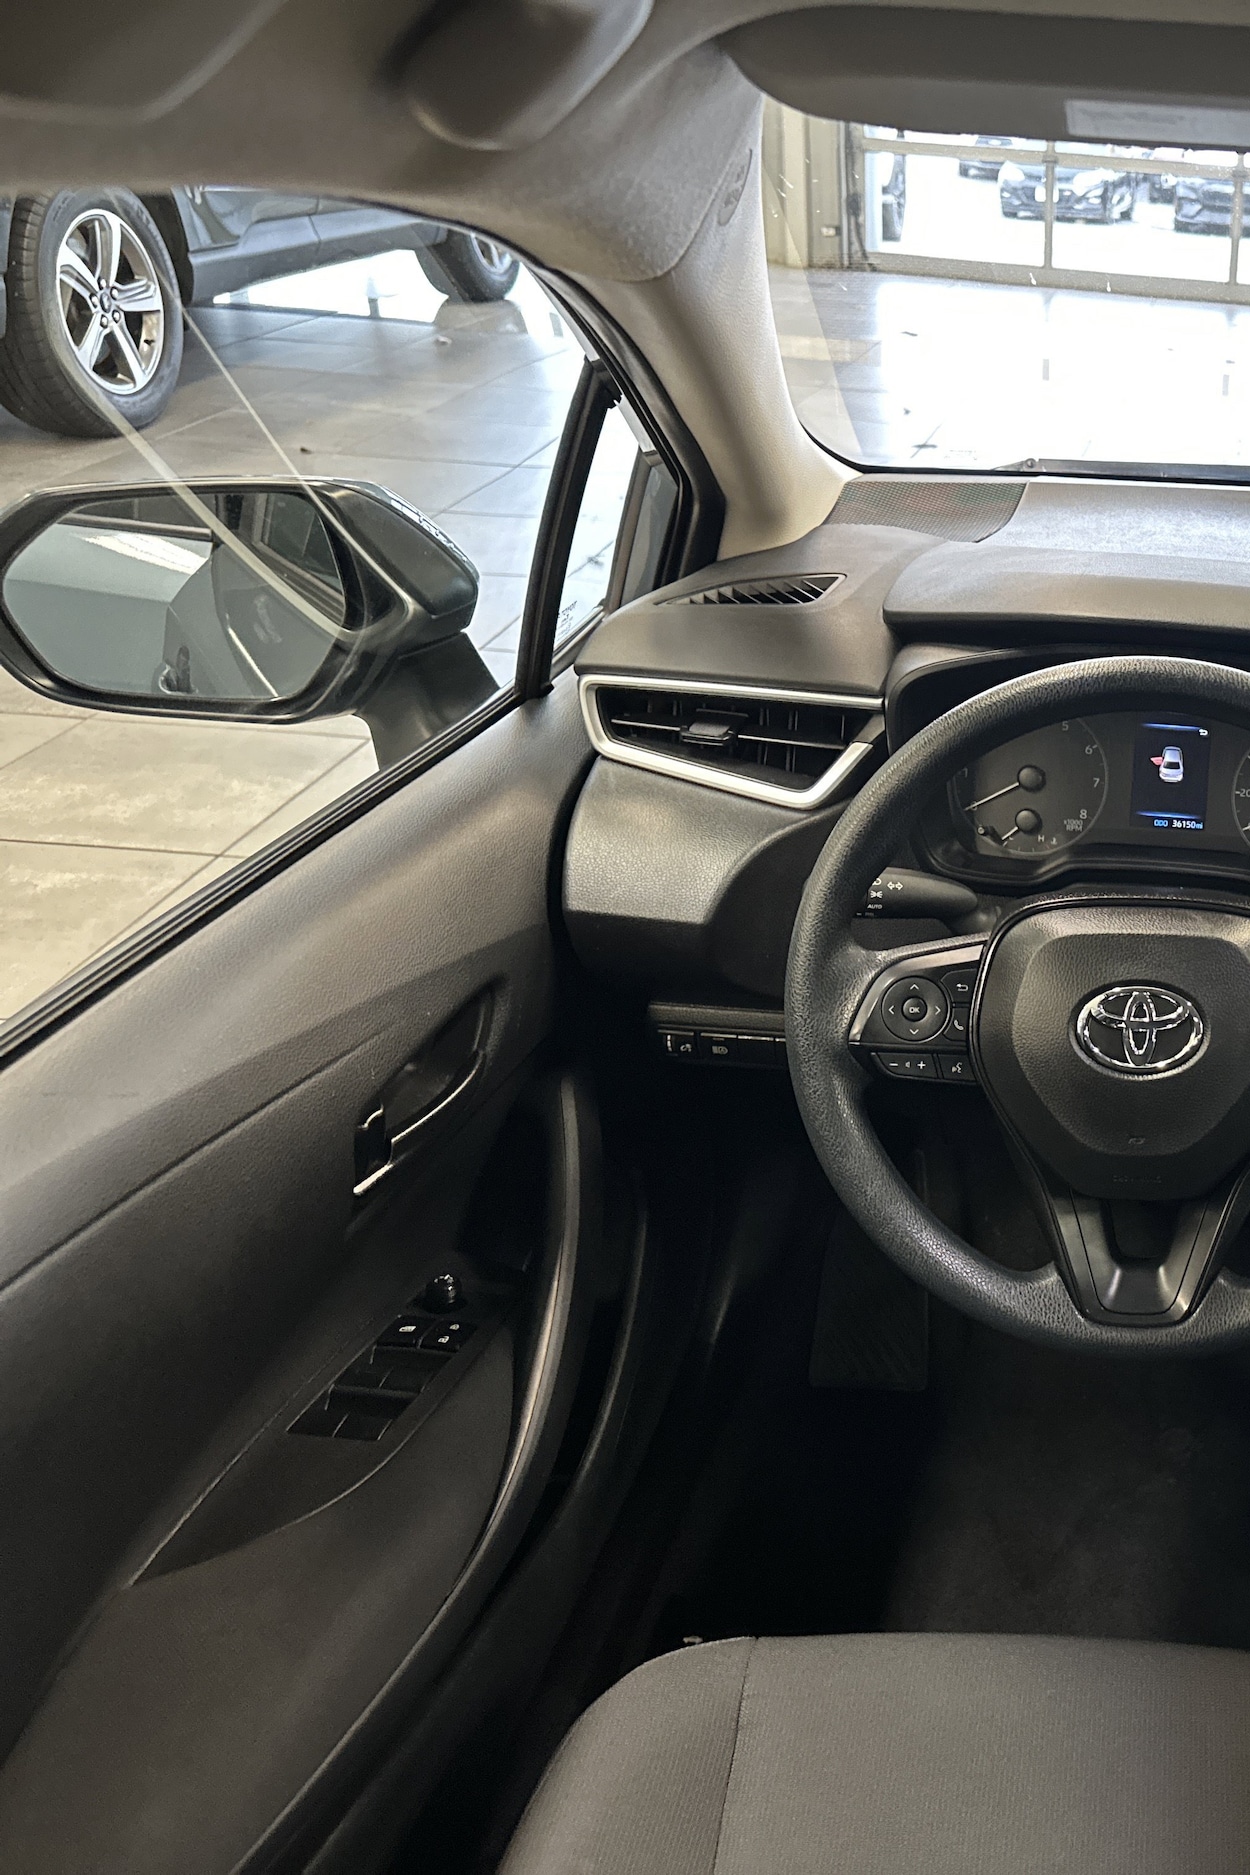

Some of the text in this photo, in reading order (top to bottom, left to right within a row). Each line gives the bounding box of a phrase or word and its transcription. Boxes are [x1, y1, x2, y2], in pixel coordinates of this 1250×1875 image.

[1084, 745, 1093, 755] 6
[1093, 777, 1100, 788] 7
[1079, 809, 1088, 820] 8
[1037, 834, 1045, 842] H
[908, 1006, 920, 1014] OK
